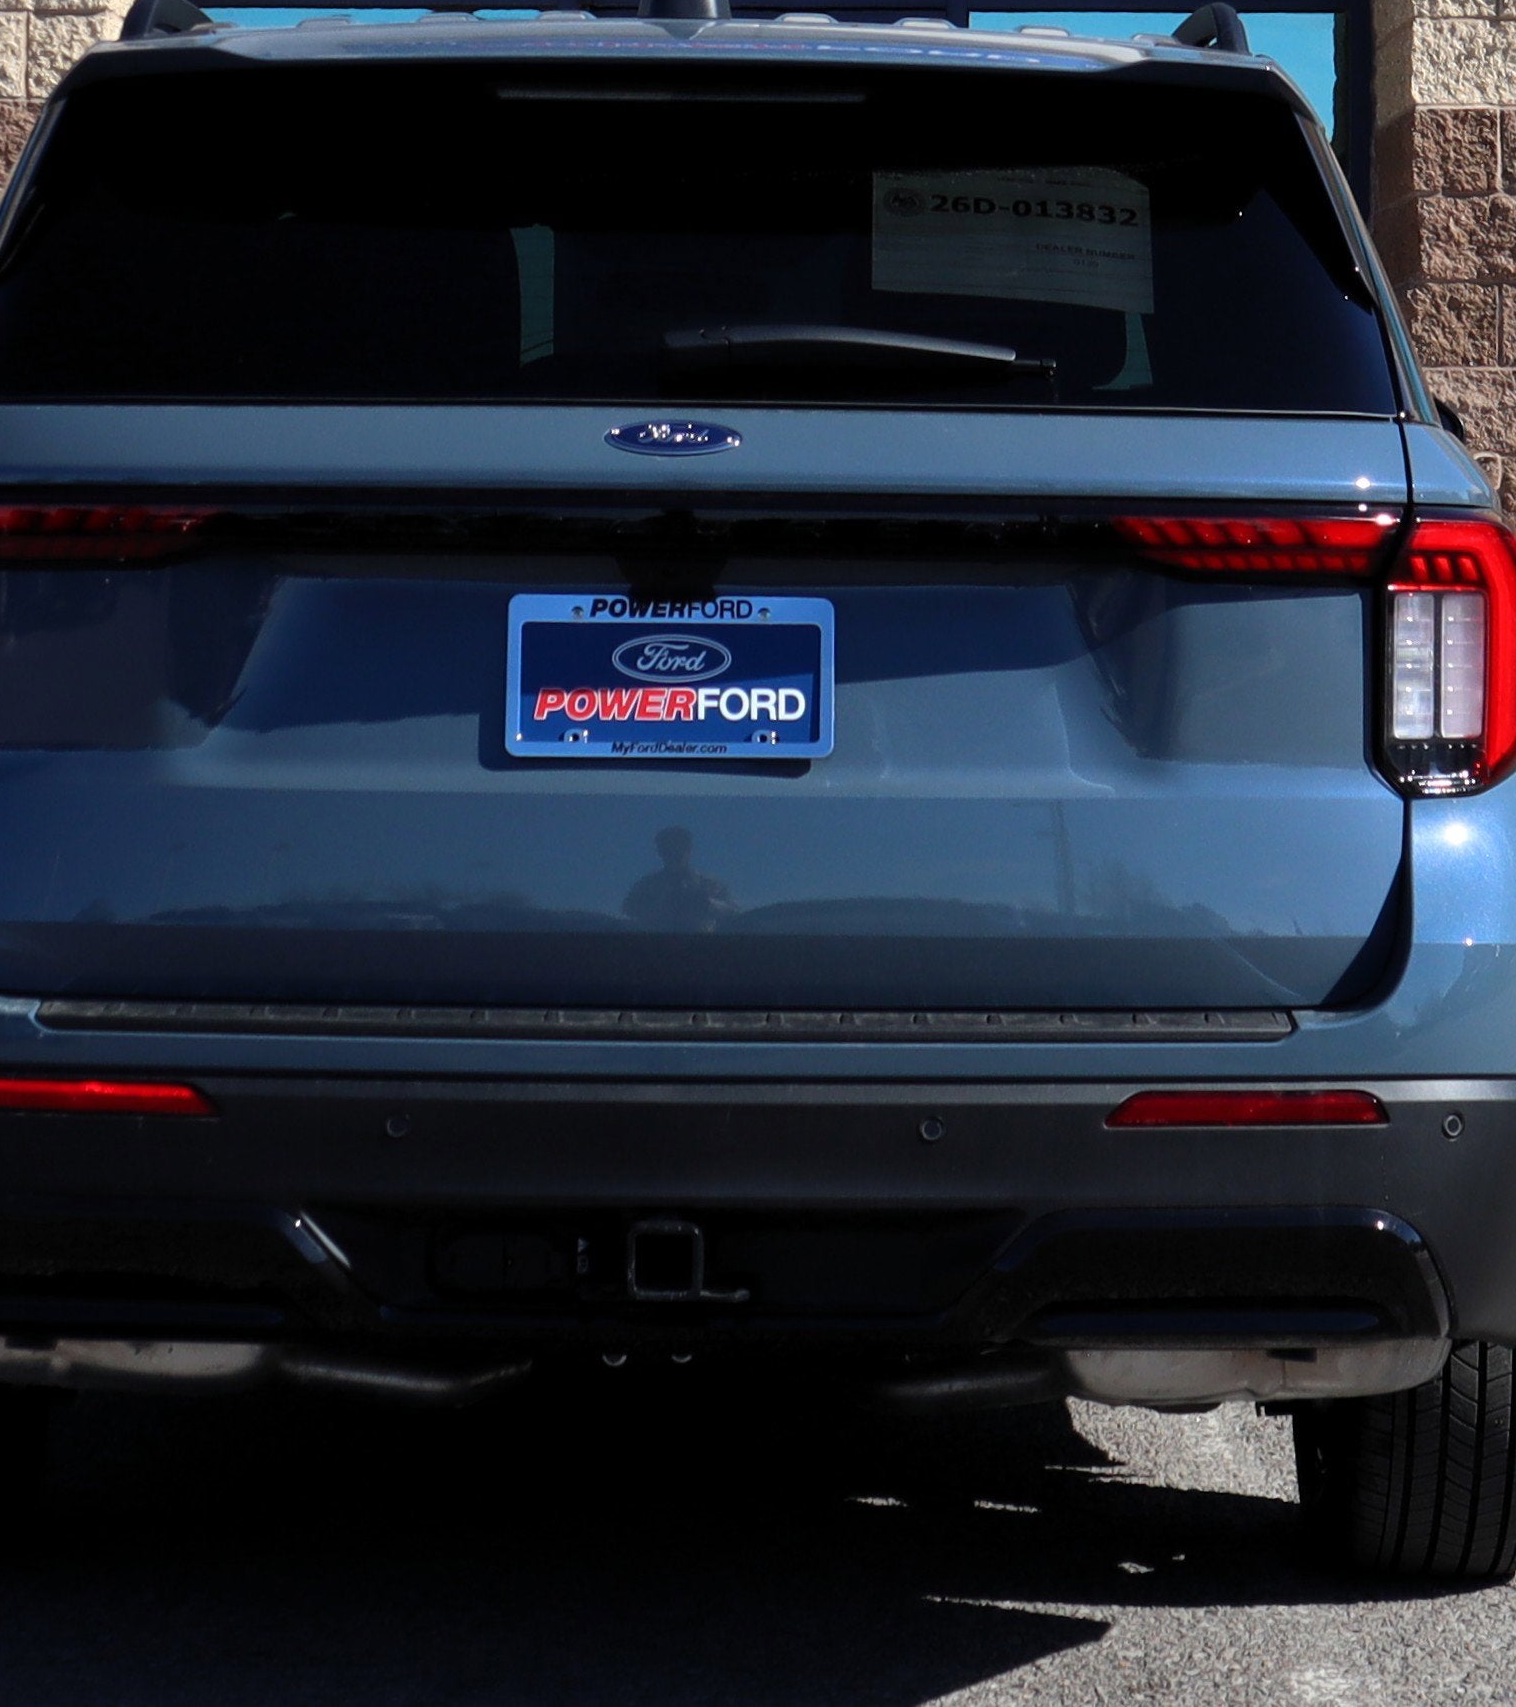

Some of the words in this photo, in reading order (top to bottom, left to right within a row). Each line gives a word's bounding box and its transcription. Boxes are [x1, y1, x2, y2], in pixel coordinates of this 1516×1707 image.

[930, 194, 1138, 227] 26D-013832
[589, 598, 753, 619] POWERFORD
[636, 643, 706, 672] Ford
[534, 687, 806, 721] POWERFORD
[611, 740, 728, 755] MyFordDealer.com
